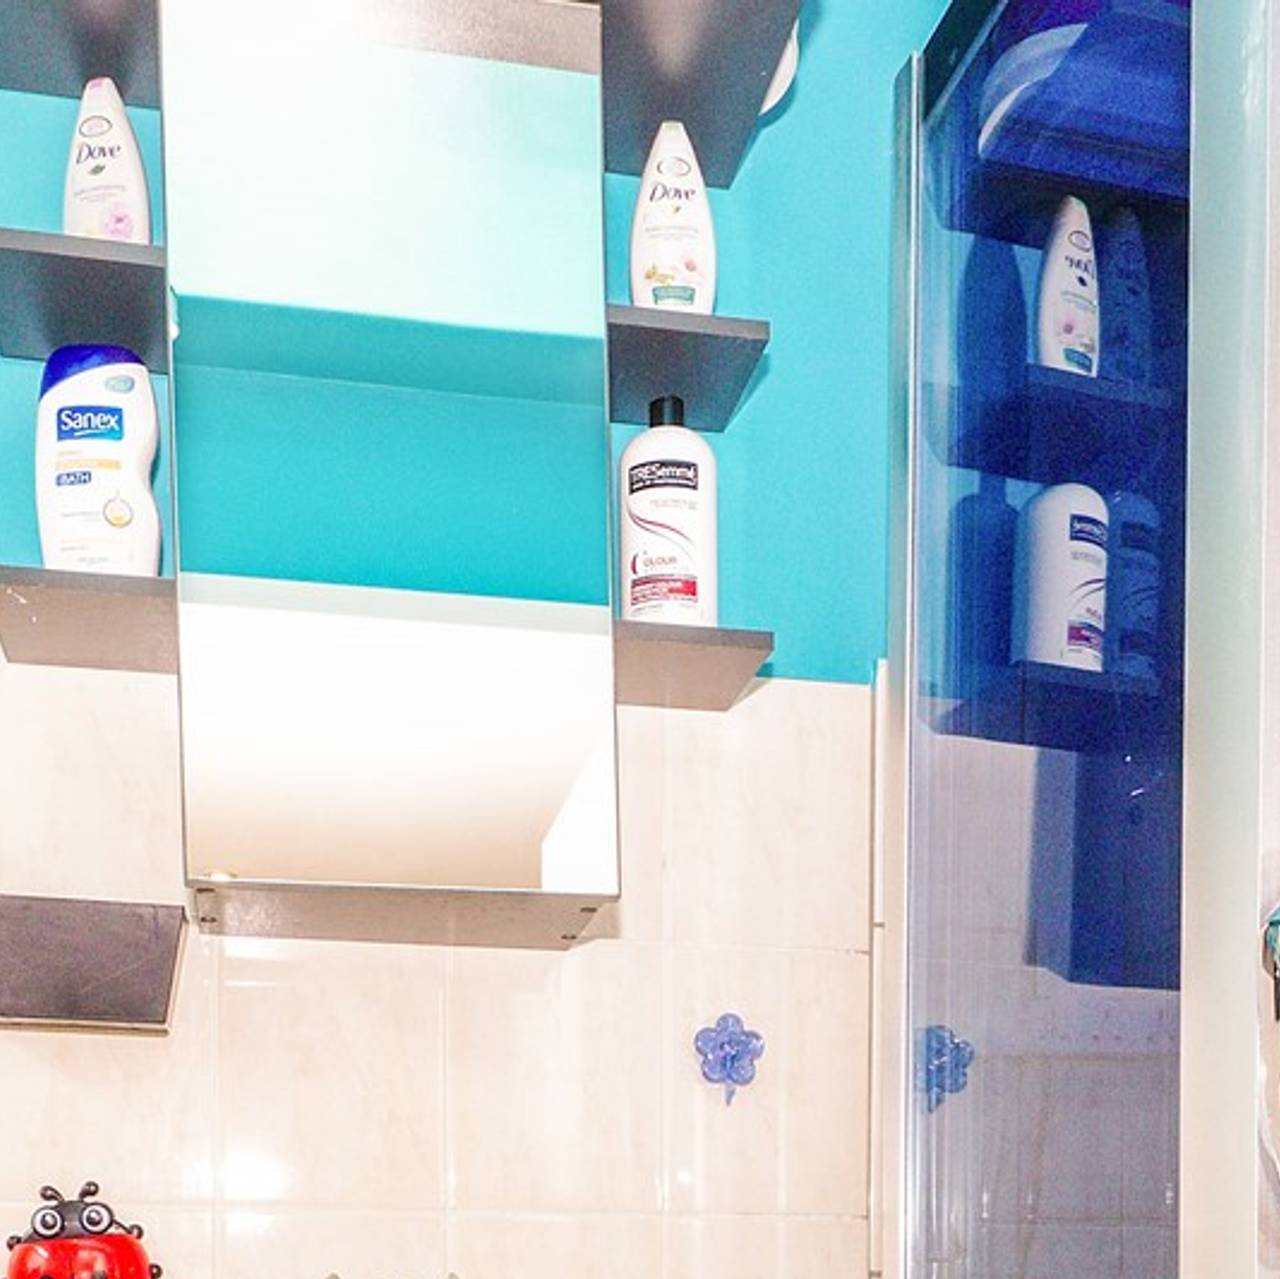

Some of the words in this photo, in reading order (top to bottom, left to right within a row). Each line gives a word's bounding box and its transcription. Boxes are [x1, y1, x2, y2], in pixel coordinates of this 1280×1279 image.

[75, 141, 123, 166] Dove
[648, 179, 697, 203] Dove
[60, 409, 121, 432] Sanex
